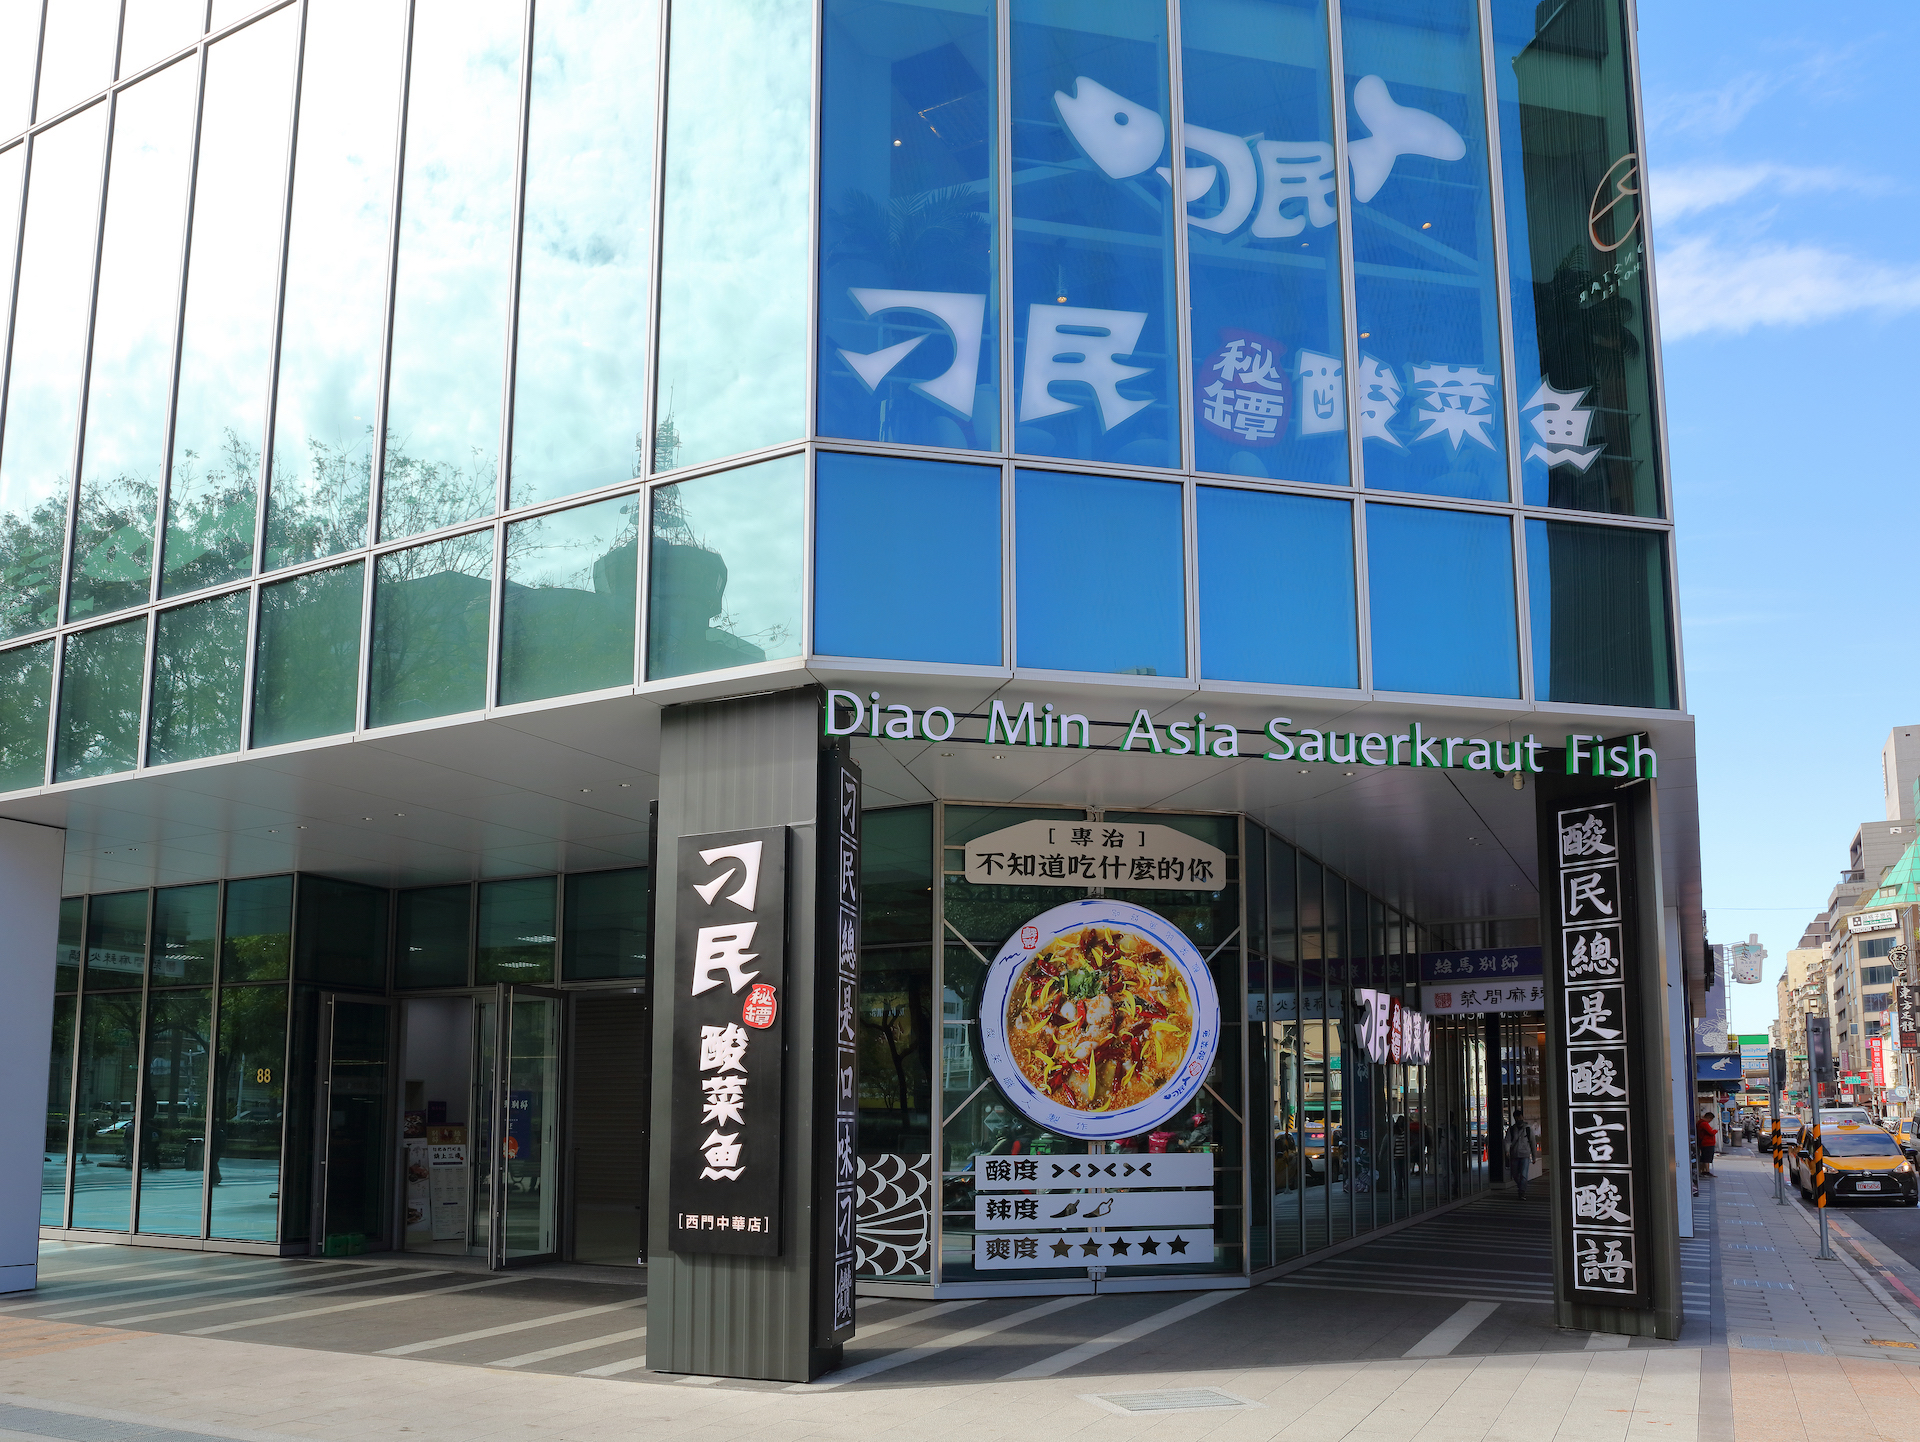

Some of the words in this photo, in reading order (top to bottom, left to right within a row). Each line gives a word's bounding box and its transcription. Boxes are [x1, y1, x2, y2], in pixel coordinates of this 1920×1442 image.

[835, 287, 1158, 432] 刁民
[1299, 349, 1606, 471] 酸菜魚
[825, 689, 955, 742] Diao
[985, 699, 1090, 748] Min
[1118, 708, 1240, 757] Asia
[1263, 717, 1544, 772] Sauerkraut
[1565, 733, 1658, 779] Fish
[975, 852, 1214, 882] 不知道吃什麼的你
[692, 841, 763, 996] 刁民
[1563, 813, 1633, 1284] 酸民總是酸言酸語
[257, 1068, 271, 1083] 88
[700, 1022, 749, 1181] 酸菜魚
[986, 1159, 1039, 1181] 酸度
[678, 1213, 770, 1233] [西門中華店]
[986, 1198, 1039, 1221] 辣度
[986, 1236, 1039, 1261] 爽度
